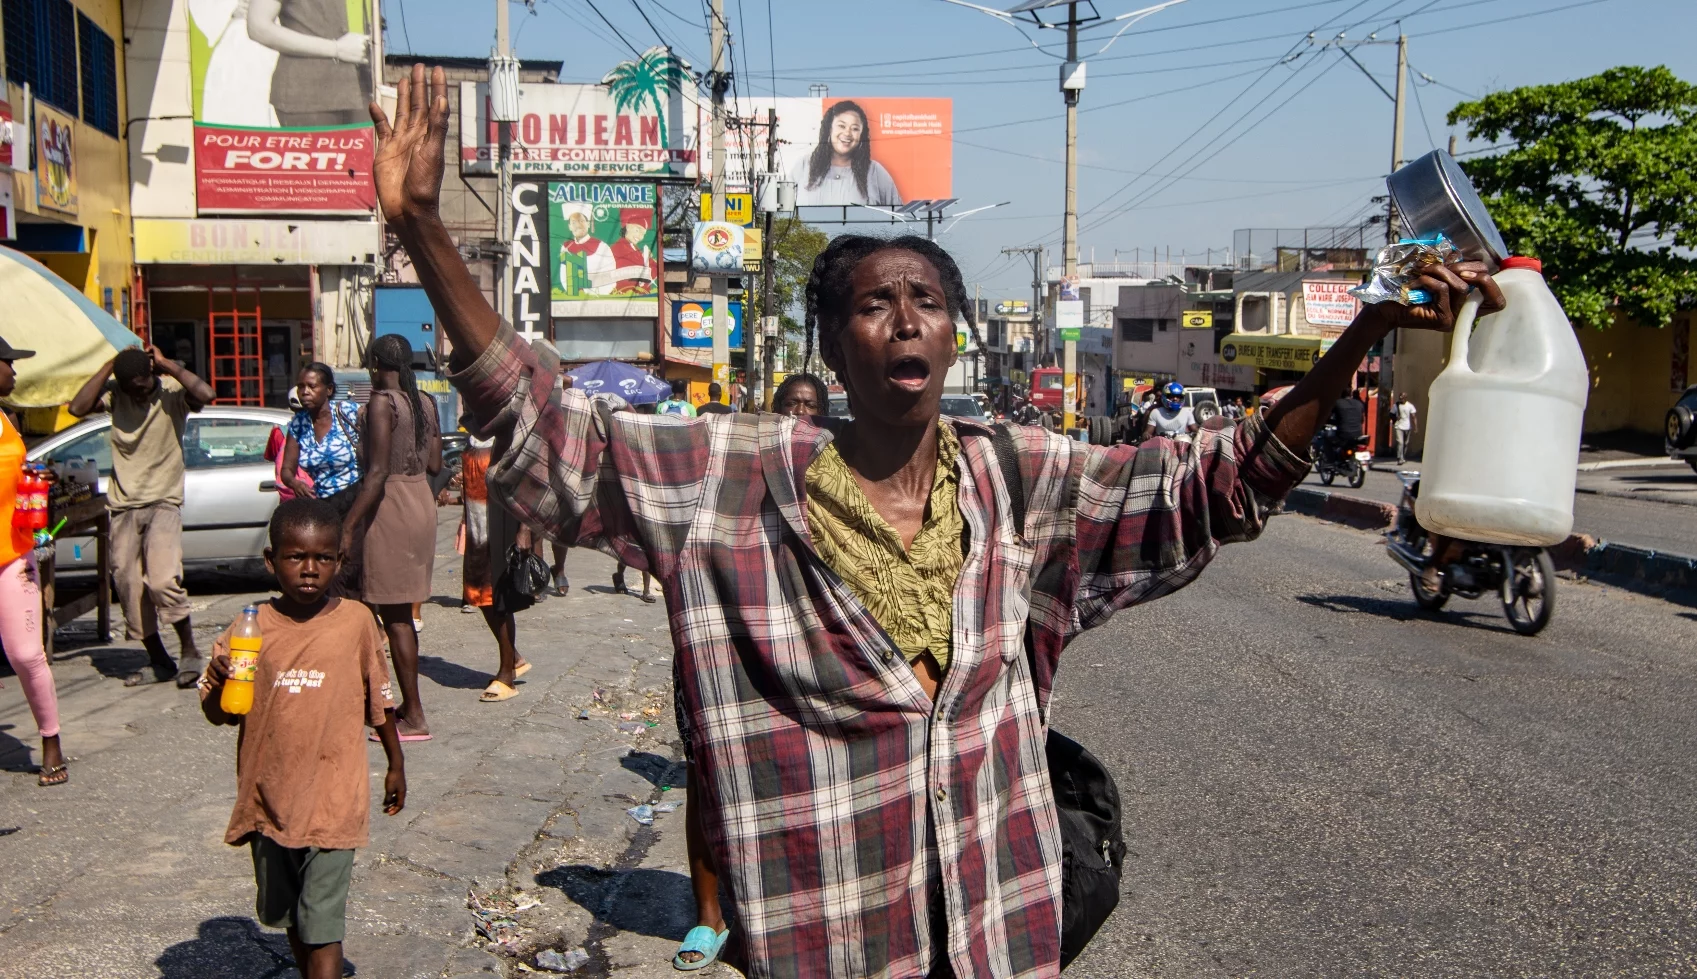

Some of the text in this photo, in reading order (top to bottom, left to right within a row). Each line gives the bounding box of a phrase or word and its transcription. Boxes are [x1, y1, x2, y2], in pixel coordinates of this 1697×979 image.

[204, 135, 260, 148] POUR
[317, 138, 364, 150] PLUS
[224, 150, 347, 170] FORT!
[476, 148, 683, 162] CETRE COMMERCIAL
[563, 163, 591, 172] BON
[593, 163, 645, 172] SERVICE
[553, 183, 654, 204] ALLIANCE
[190, 223, 248, 249] BON
[1309, 284, 1348, 293] COLLEGE
[1319, 294, 1333, 302] MARIE
[1224, 349, 1236, 357] CAM
[1238, 345, 1257, 357] BUREAU
[1257, 346, 1265, 357] DE
[1266, 346, 1293, 360] TRANSFERT
[1294, 348, 1310, 361] AGREE
